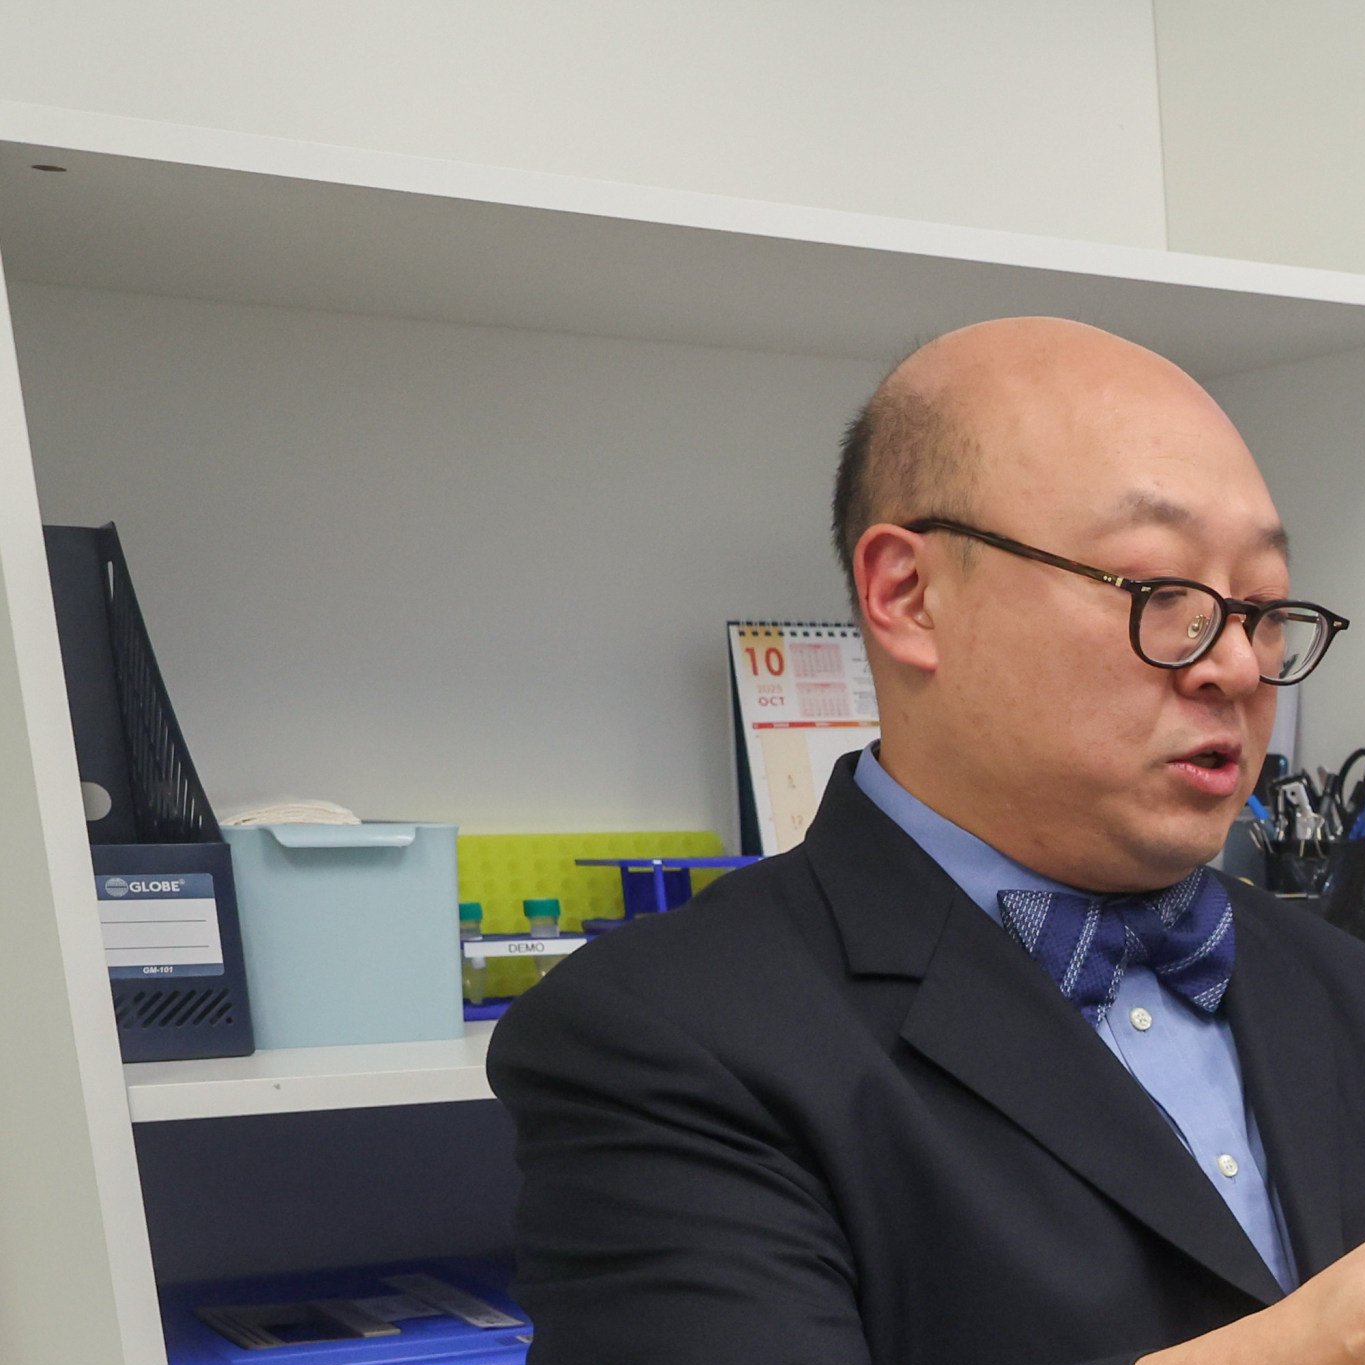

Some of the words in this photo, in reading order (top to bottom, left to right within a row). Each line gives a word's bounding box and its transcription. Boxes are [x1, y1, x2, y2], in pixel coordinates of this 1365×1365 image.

[745, 647, 784, 677] 10
[758, 697, 784, 706] OCT
[508, 943, 545, 954] DEMO
[142, 966, 174, 974] GM-101
